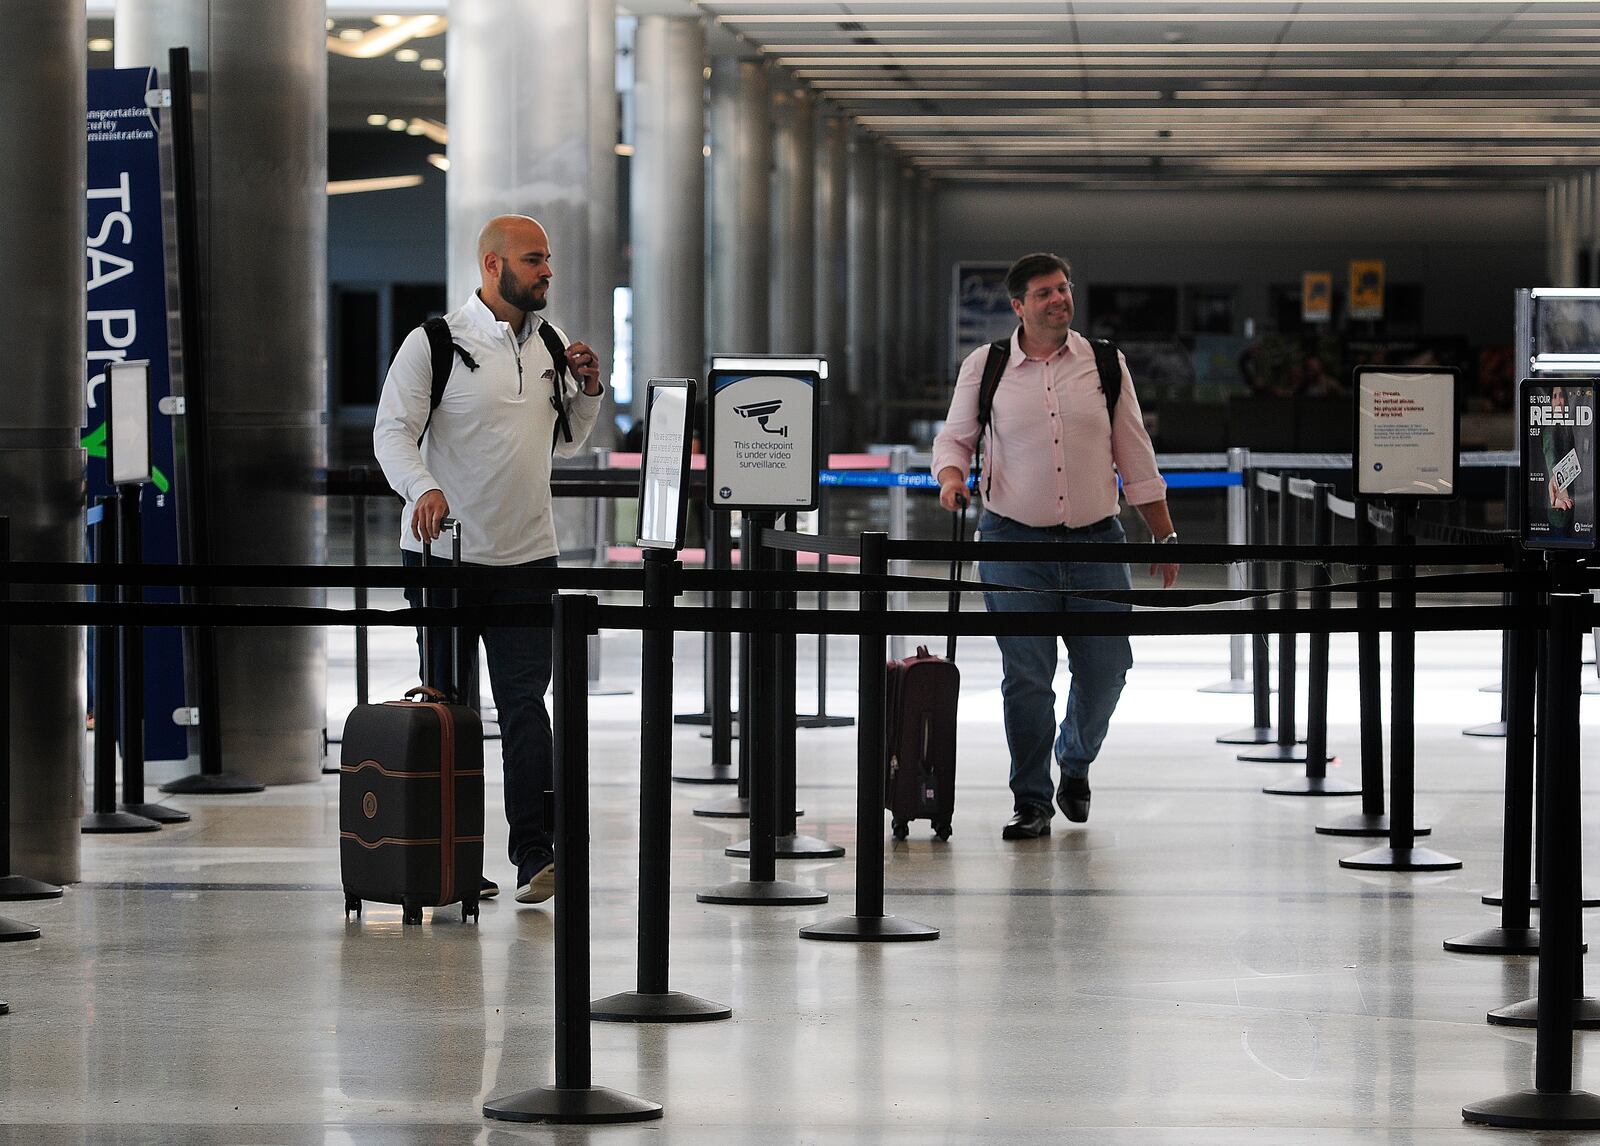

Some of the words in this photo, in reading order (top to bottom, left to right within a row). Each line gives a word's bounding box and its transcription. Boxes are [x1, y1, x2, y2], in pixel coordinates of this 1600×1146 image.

[87, 120, 117, 131] urity
[87, 172, 134, 291] TSA
[1537, 395, 1550, 403] YOUR
[1530, 405, 1575, 426] REAL
[1576, 405, 1593, 426] ID
[1530, 428, 1540, 436] SELF
[734, 441, 749, 450] This
[751, 441, 793, 451] checkpoint
[769, 451, 791, 459] video
[739, 460, 787, 469] surveillance.
[897, 474, 926, 486] Enroll
